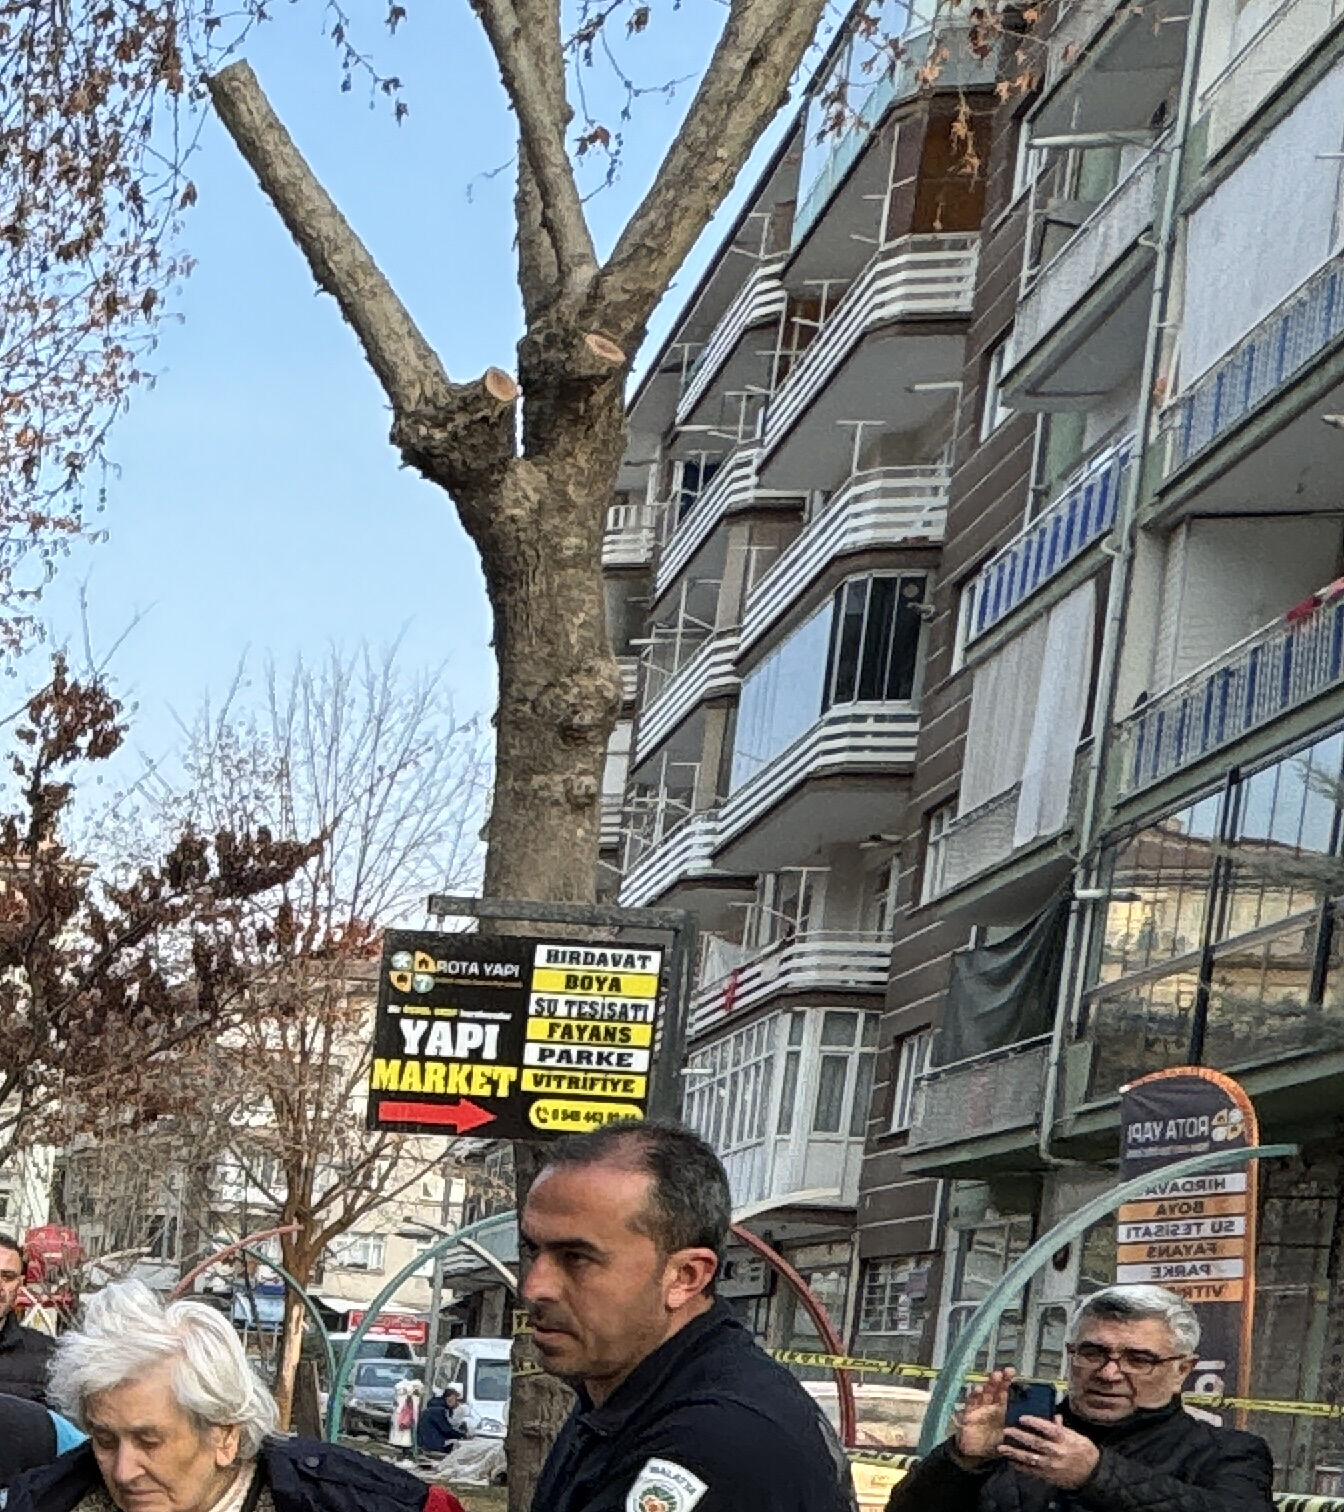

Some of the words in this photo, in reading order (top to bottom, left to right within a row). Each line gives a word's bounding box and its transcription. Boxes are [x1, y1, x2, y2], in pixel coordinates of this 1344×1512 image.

[436, 960, 480, 976] ROTA
[482, 962, 521, 978] YAPI
[545, 948, 652, 970] HIRDAVAT
[564, 974, 623, 993] BOYA
[534, 997, 559, 1018] SU
[399, 1018, 500, 1060] YAPI
[547, 1022, 632, 1043] FAYANS
[537, 1046, 633, 1068] PARKE
[371, 1058, 518, 1098] MARKET
